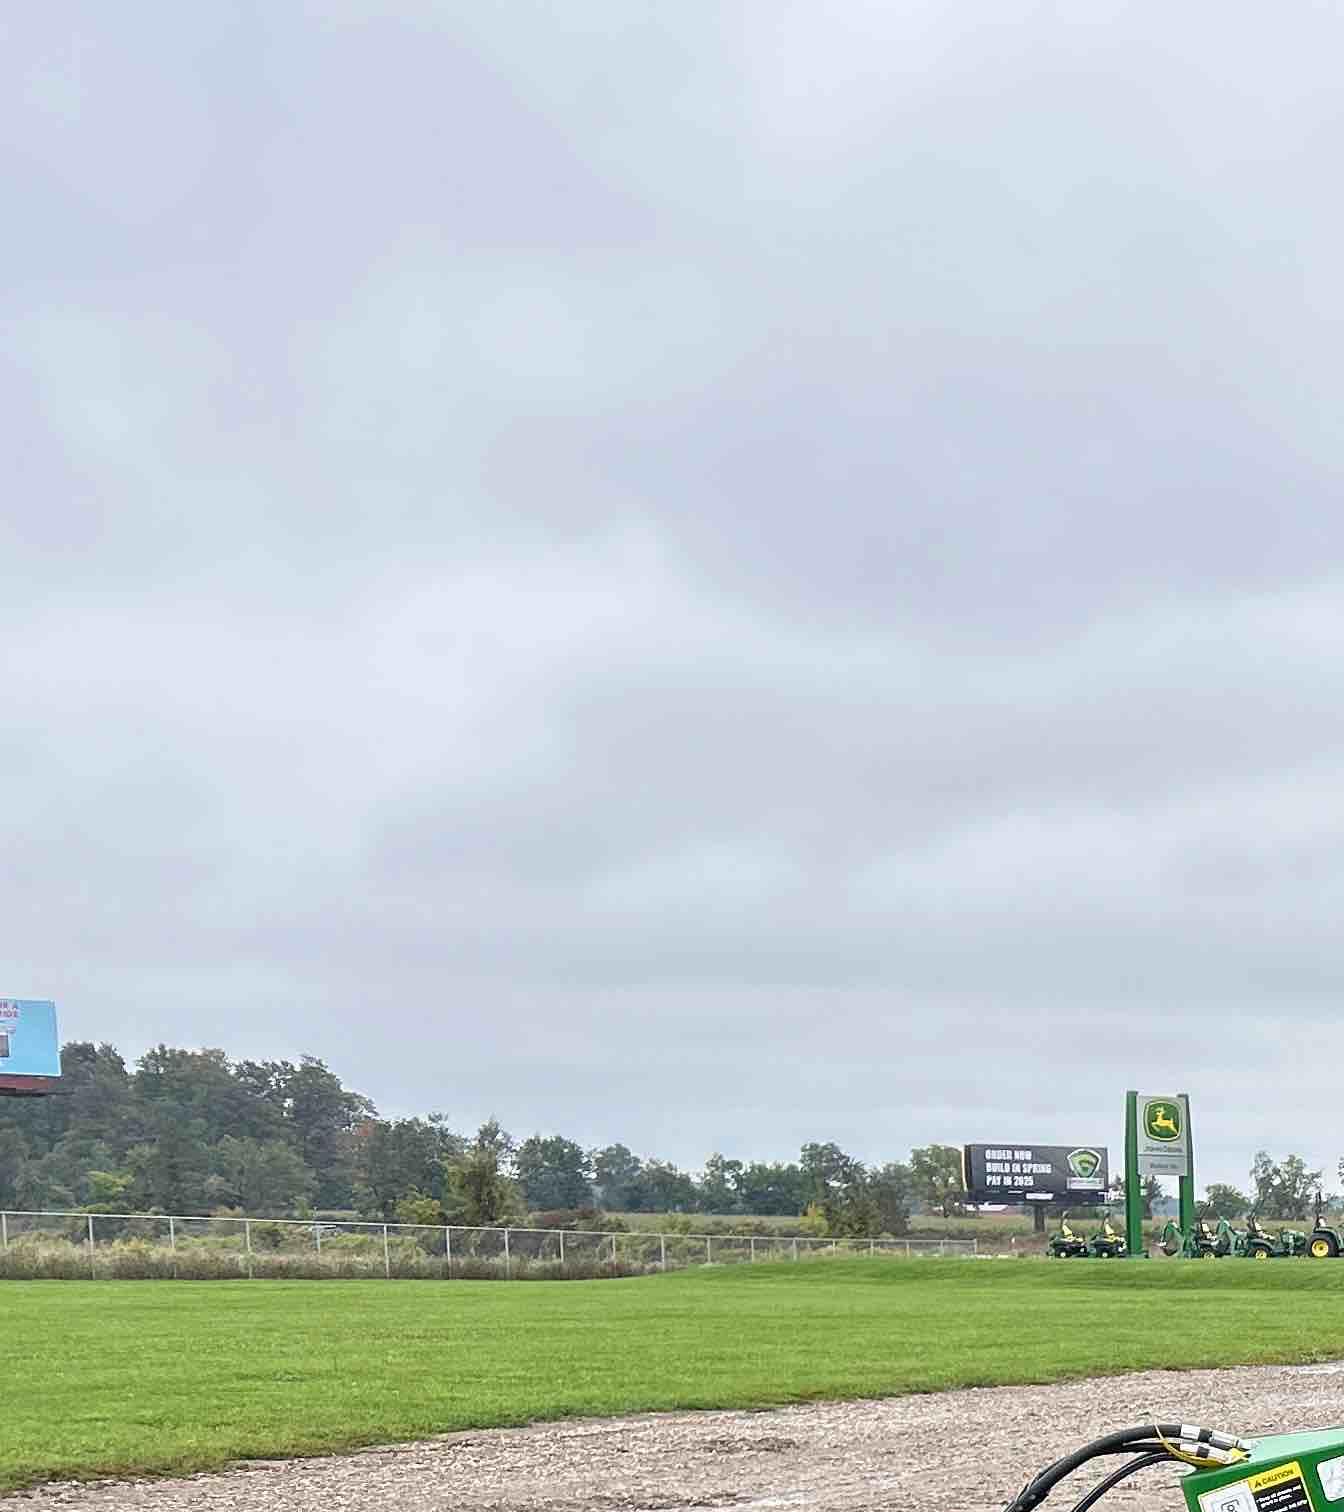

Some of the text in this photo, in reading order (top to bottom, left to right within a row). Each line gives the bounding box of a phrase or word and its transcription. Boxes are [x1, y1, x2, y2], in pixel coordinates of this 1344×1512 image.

[985, 1162, 1052, 1174] BUILD IN SPRING
[986, 1175, 1034, 1186] PAY IN 2025
[1261, 1468, 1295, 1486] CAUTION
